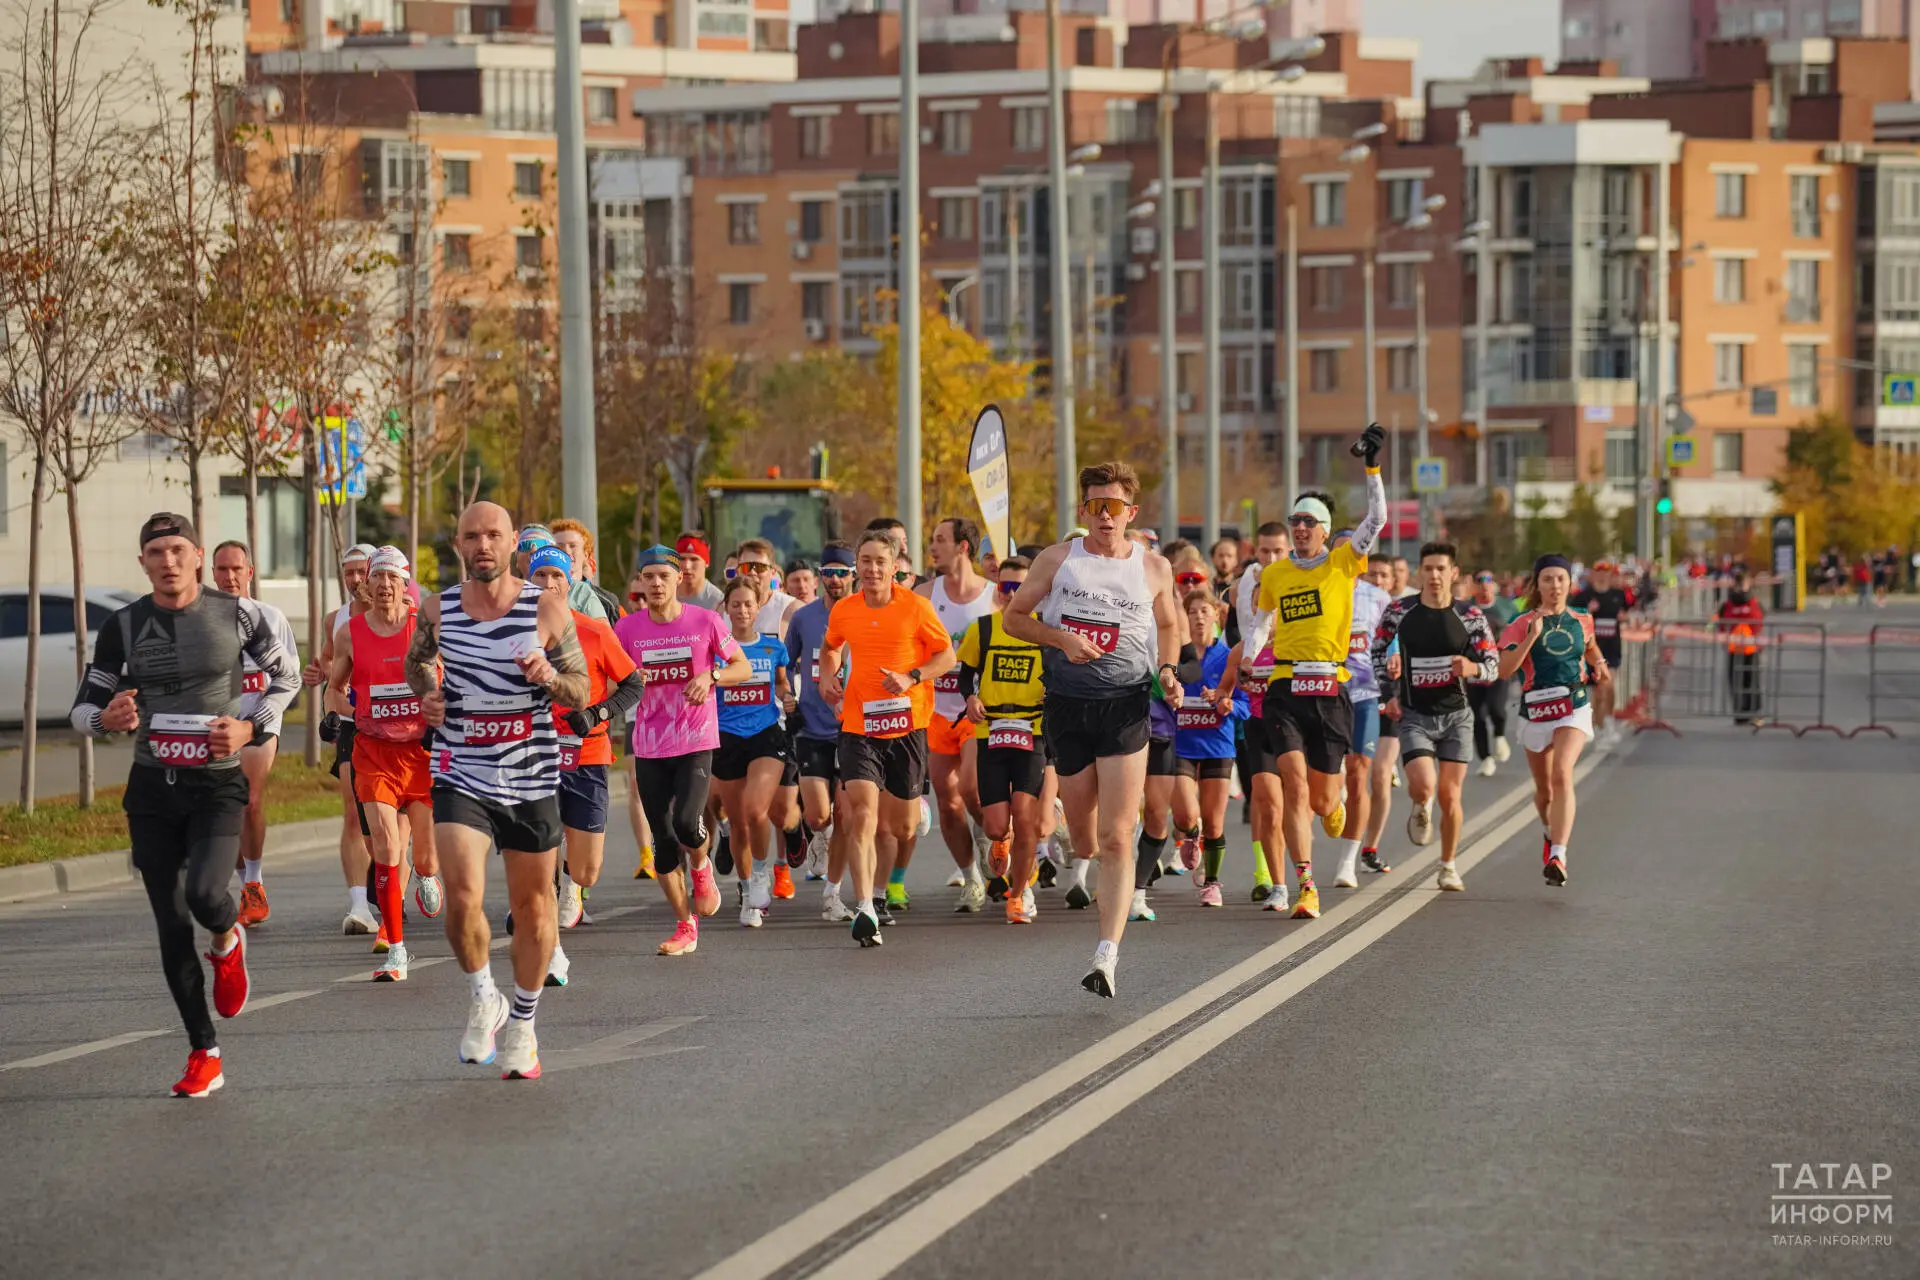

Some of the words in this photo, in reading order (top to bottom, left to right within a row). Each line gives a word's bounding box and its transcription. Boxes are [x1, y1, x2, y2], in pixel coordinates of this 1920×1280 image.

[1282, 593, 1316, 609] PACE
[1284, 603, 1318, 619] TEAM
[633, 634, 701, 648] СОВКОМБАНК
[997, 657, 1030, 669] PACE
[997, 668, 1029, 681] TEAM
